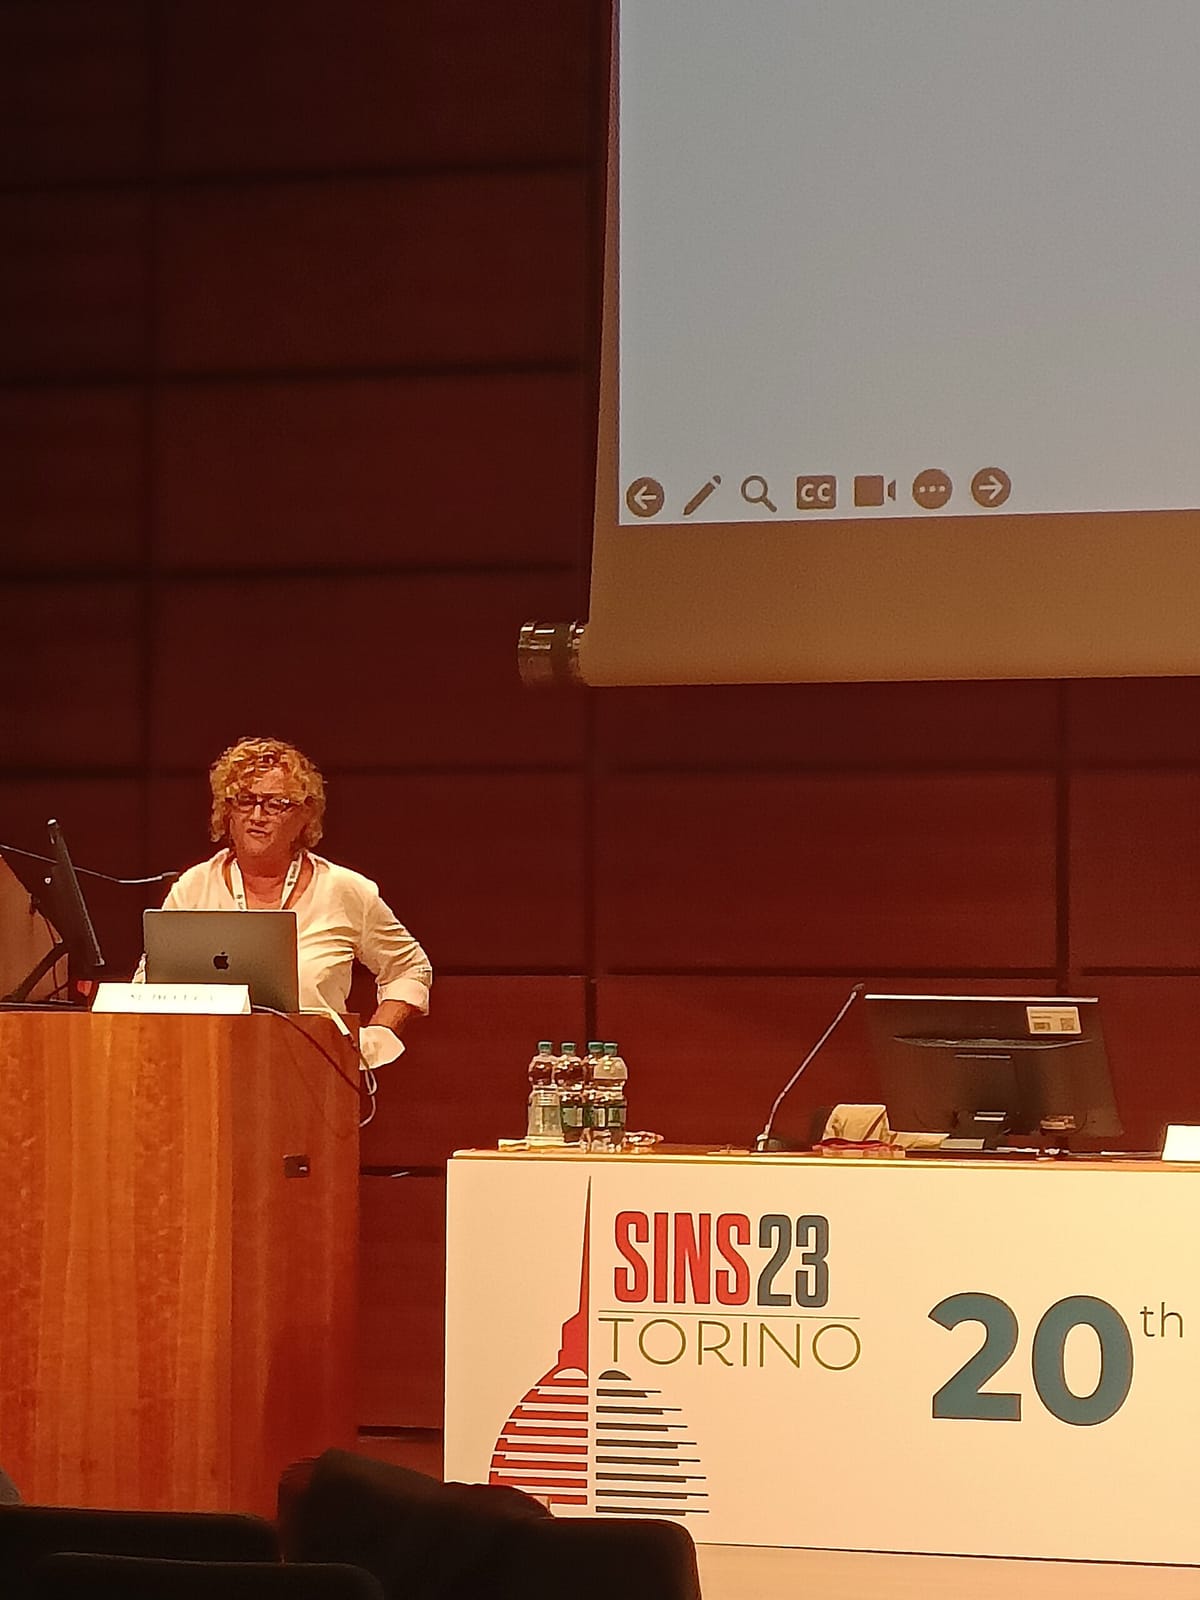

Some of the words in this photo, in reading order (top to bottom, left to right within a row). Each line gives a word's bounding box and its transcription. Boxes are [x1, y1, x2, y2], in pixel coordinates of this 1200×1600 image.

[801, 482, 831, 502] CC
[614, 1210, 829, 1308] SINS23
[599, 1318, 861, 1371] TORINO
